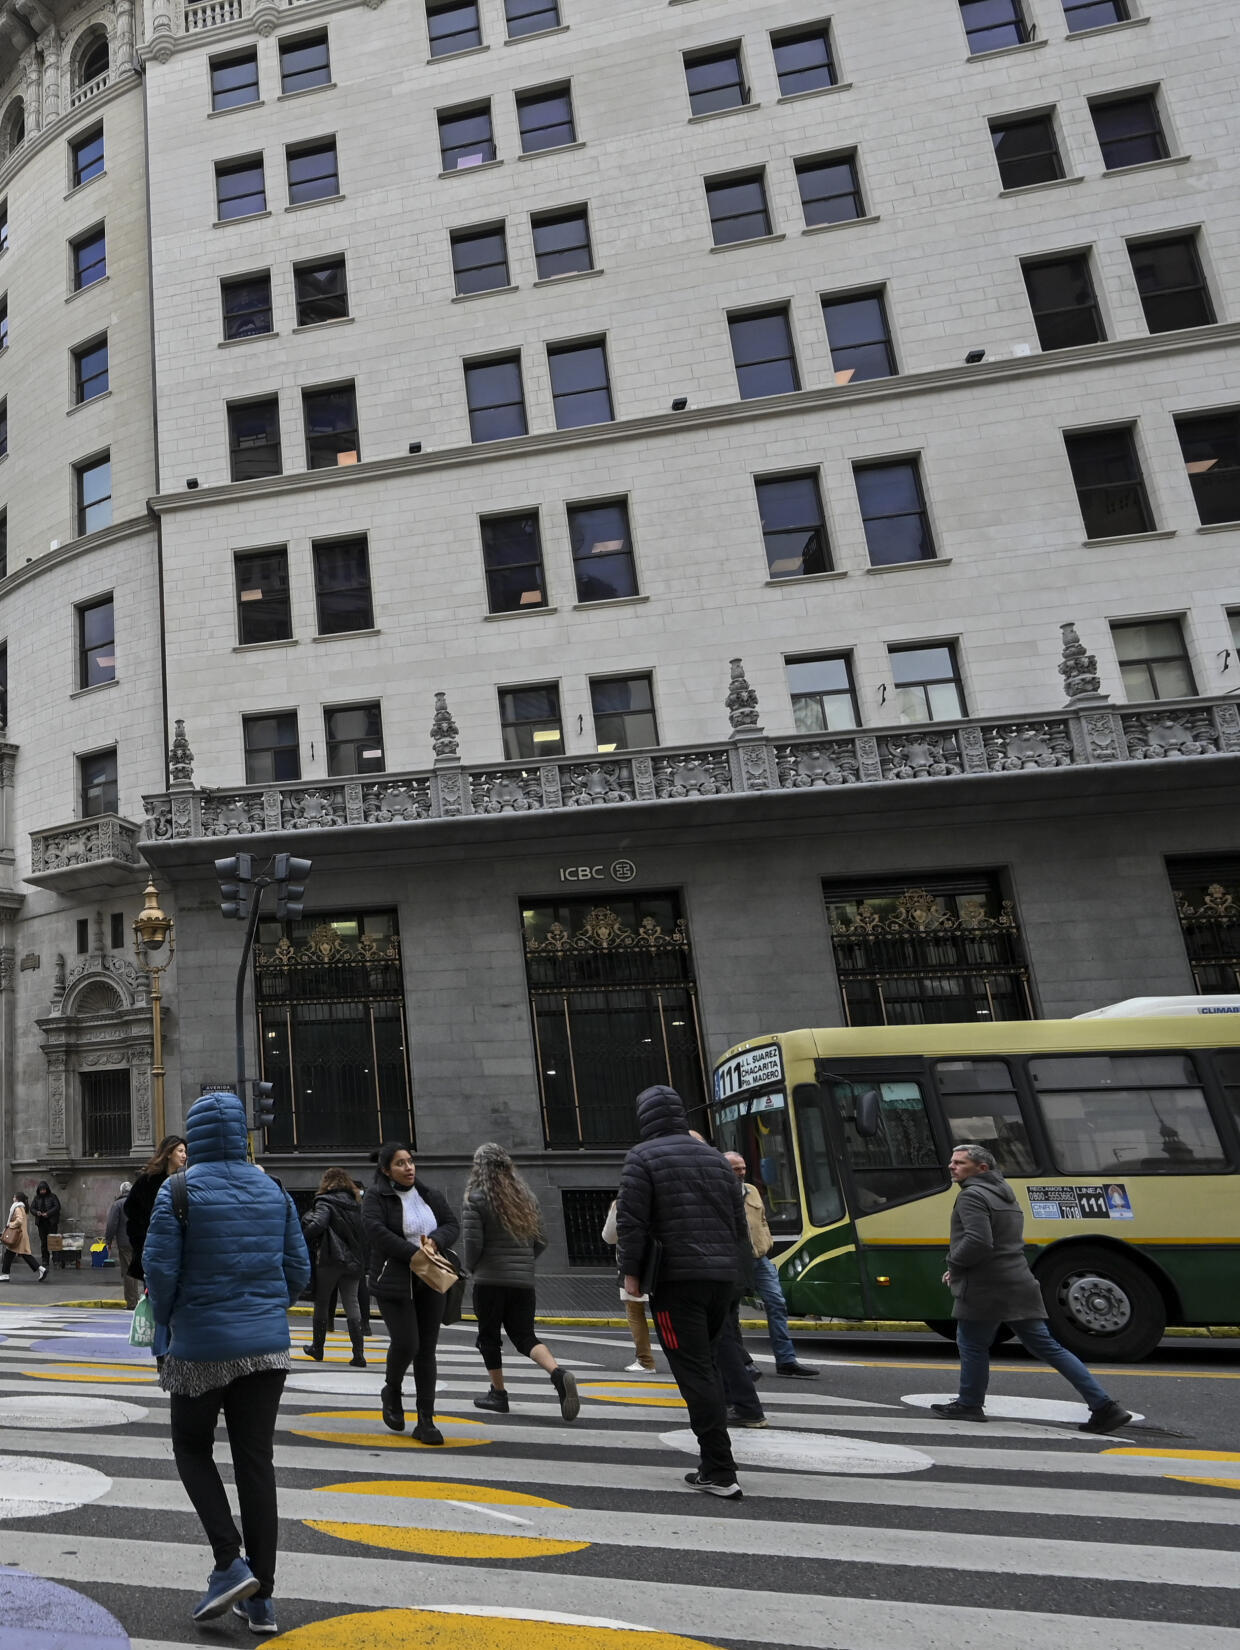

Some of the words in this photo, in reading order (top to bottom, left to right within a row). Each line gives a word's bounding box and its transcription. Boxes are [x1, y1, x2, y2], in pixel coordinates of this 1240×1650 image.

[559, 866, 605, 881] ICBC
[752, 1049, 777, 1063] SUAREZ
[741, 1060, 778, 1078] CHACARITA
[752, 1070, 779, 1083] MADERO
[720, 1061, 742, 1096] 111
[1081, 1197, 1107, 1212] 111
